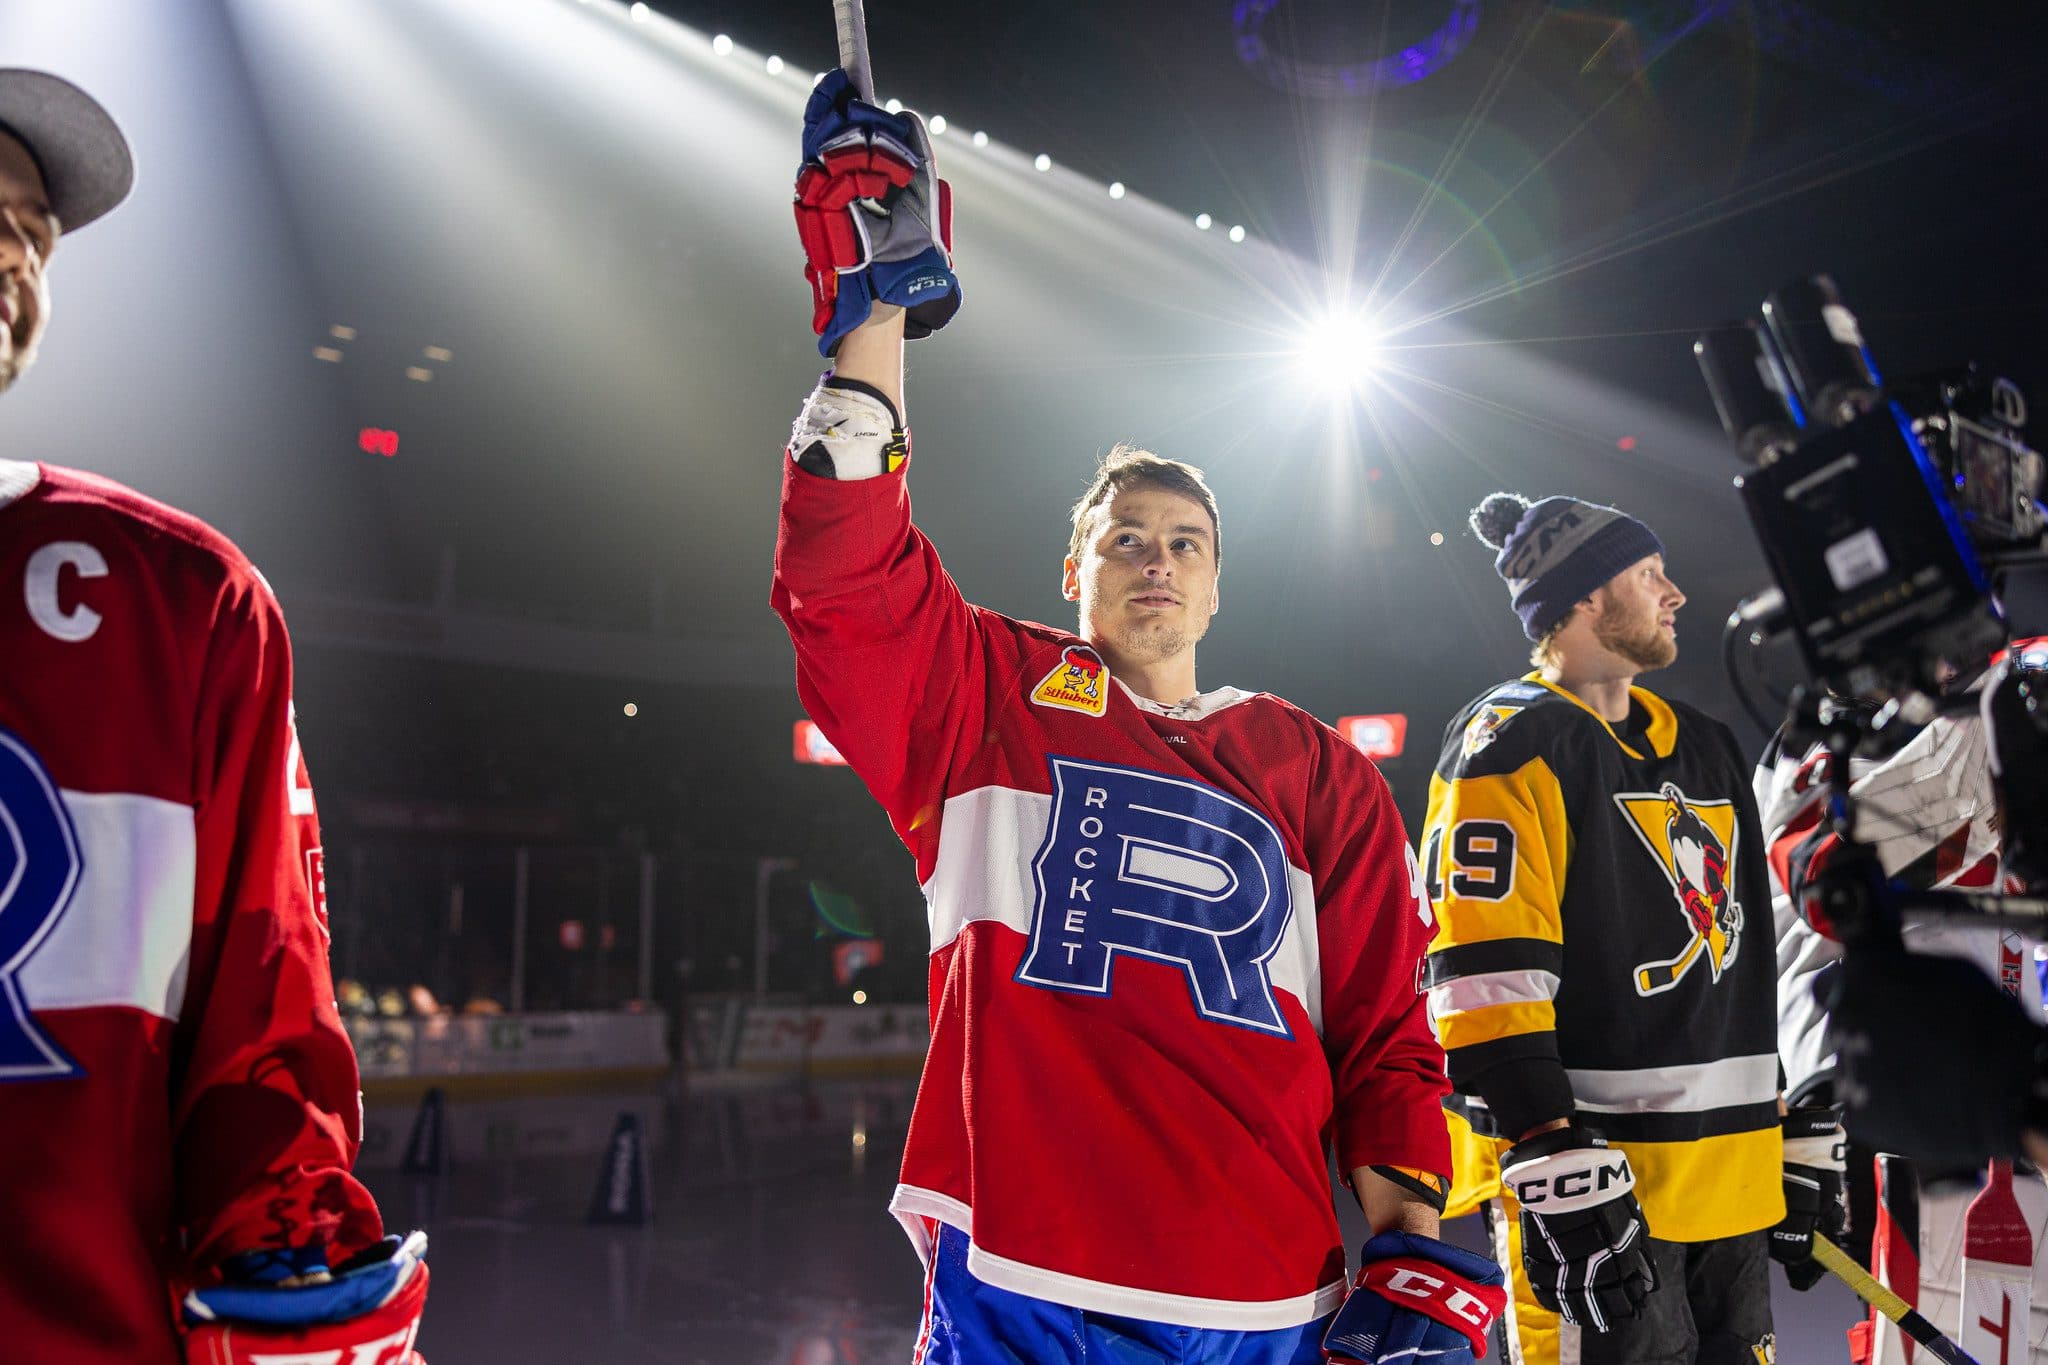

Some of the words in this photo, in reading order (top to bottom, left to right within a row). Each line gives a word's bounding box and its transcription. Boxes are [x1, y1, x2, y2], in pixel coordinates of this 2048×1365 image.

[908, 279, 947, 295] CCM
[1511, 512, 1582, 579] CM
[24, 541, 109, 642] C
[1162, 735, 1187, 744] VAL
[1061, 786, 1108, 965] ROCKET
[1422, 819, 1517, 903] 19
[1013, 753, 1296, 1042] R
[1518, 1159, 1631, 1204] CCM
[1773, 1231, 1808, 1242] CCM
